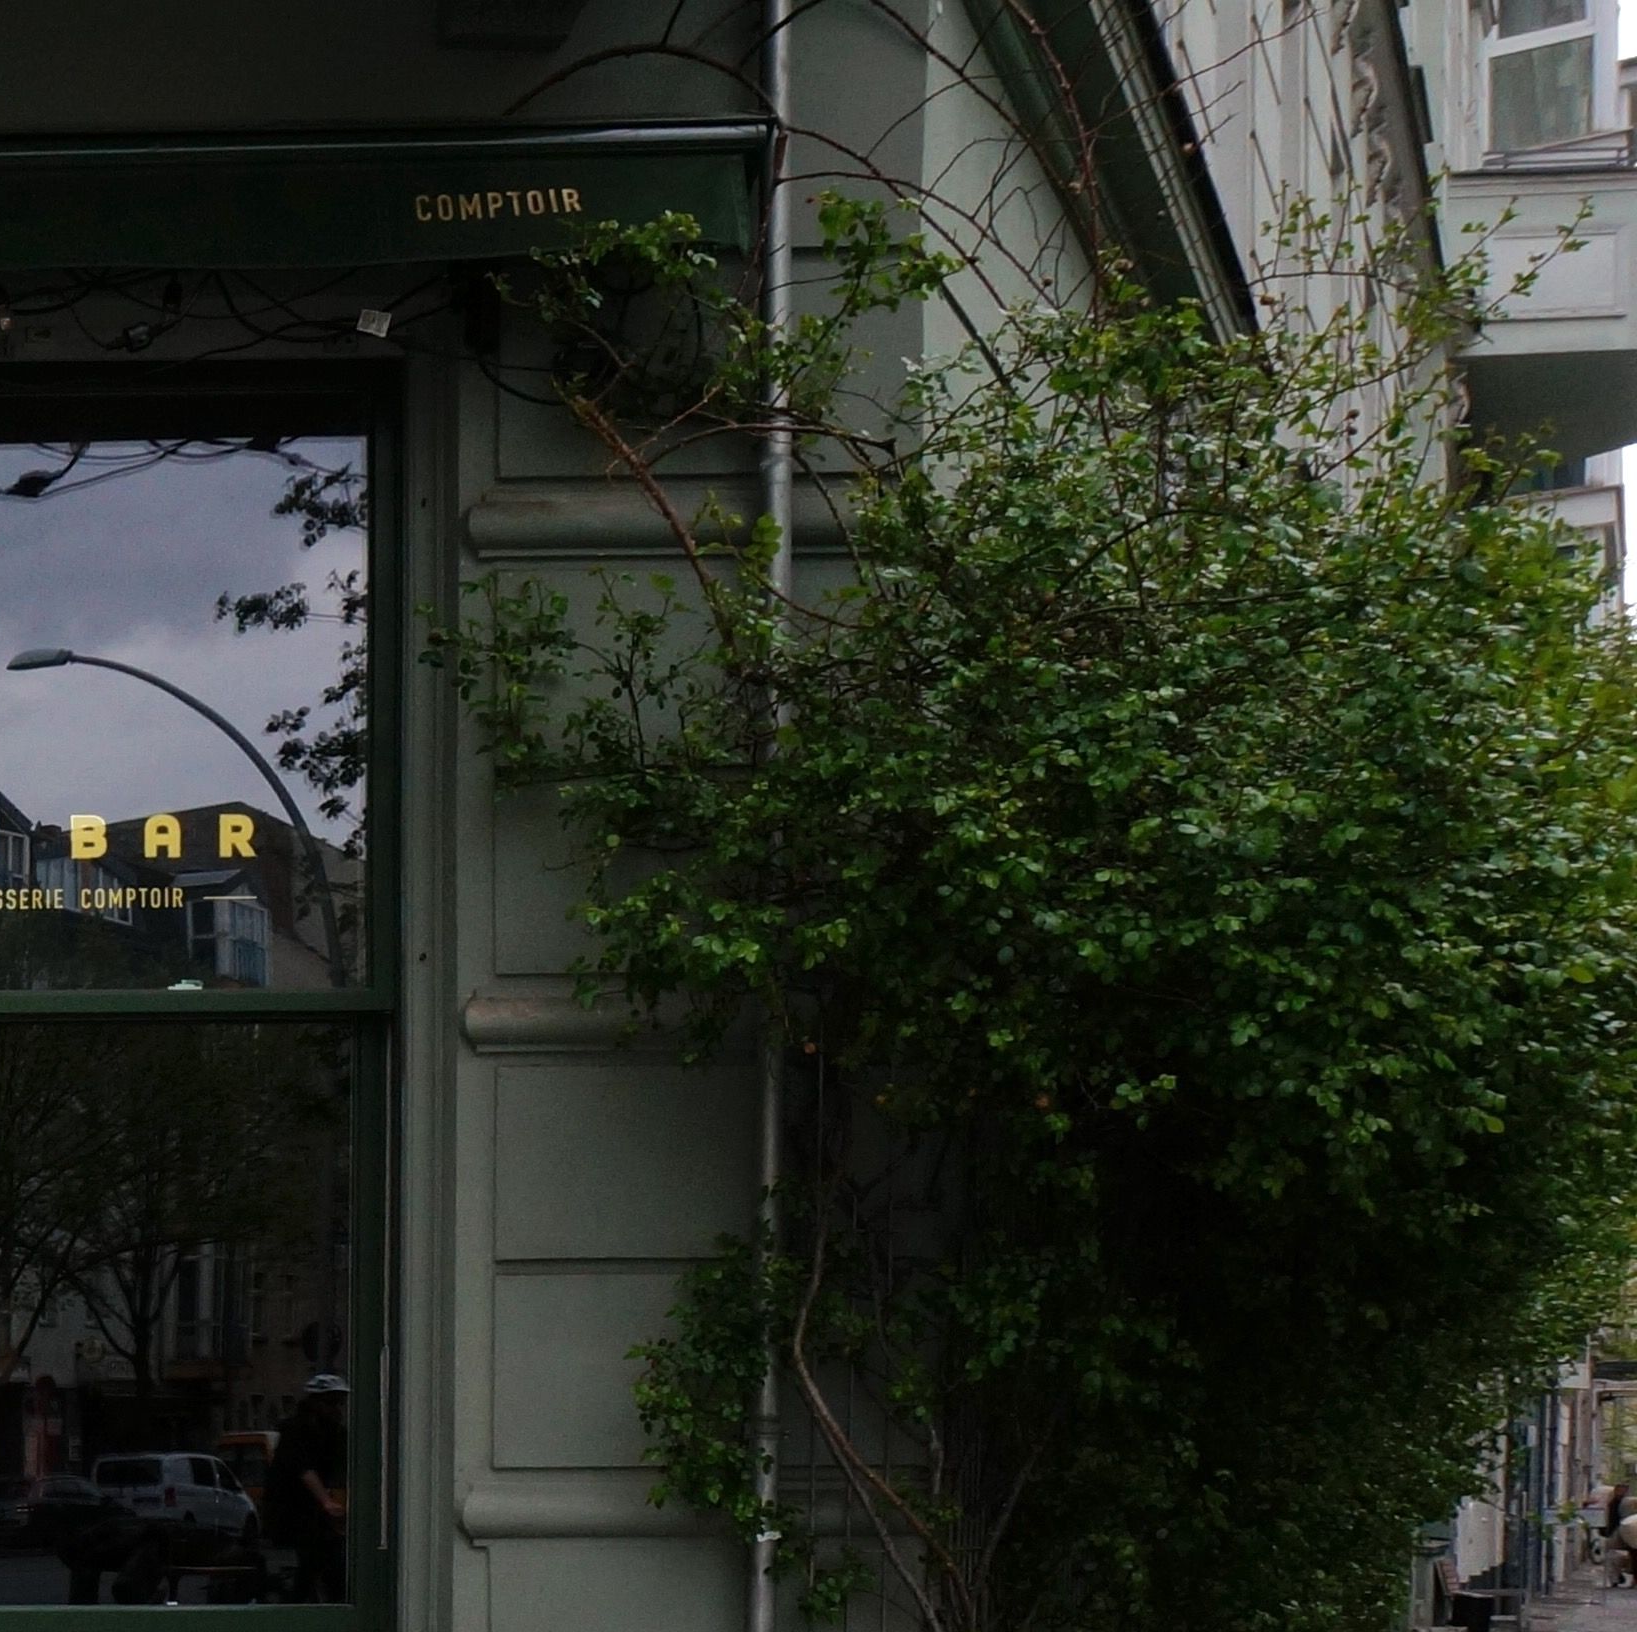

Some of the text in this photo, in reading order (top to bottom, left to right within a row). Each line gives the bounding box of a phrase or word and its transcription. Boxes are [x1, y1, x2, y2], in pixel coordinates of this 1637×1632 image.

[415, 187, 583, 223] COMPTOIR
[69, 813, 257, 861] BAR
[80, 887, 185, 910] COMPTOIR
